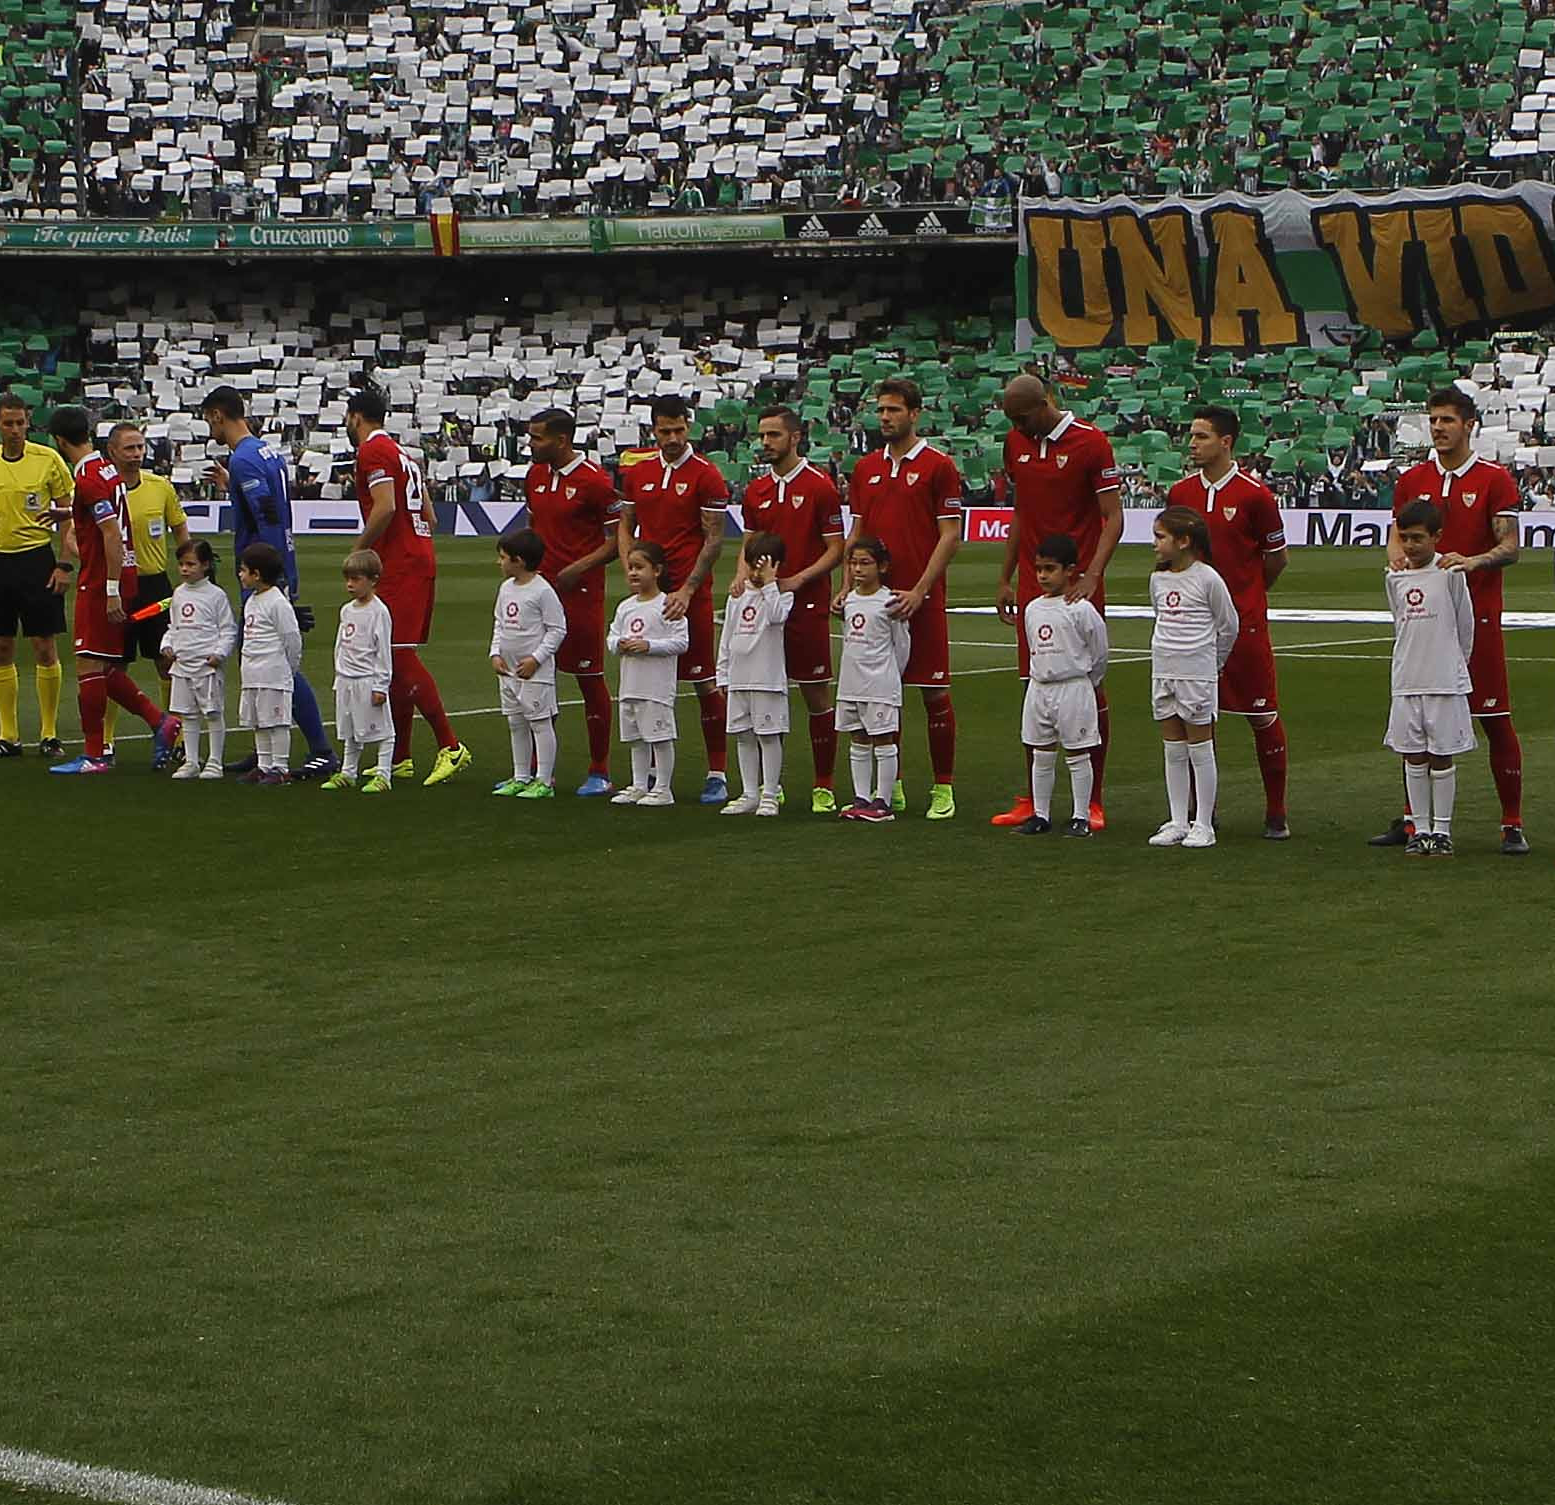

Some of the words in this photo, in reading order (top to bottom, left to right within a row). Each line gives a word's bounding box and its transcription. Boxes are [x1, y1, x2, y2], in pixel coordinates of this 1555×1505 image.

[798, 230, 830, 239] adidas
[857, 228, 889, 237] adidas
[915, 226, 947, 235] adidas
[250, 226, 348, 247] Cruzcampo
[1026, 207, 1301, 348] UNA
